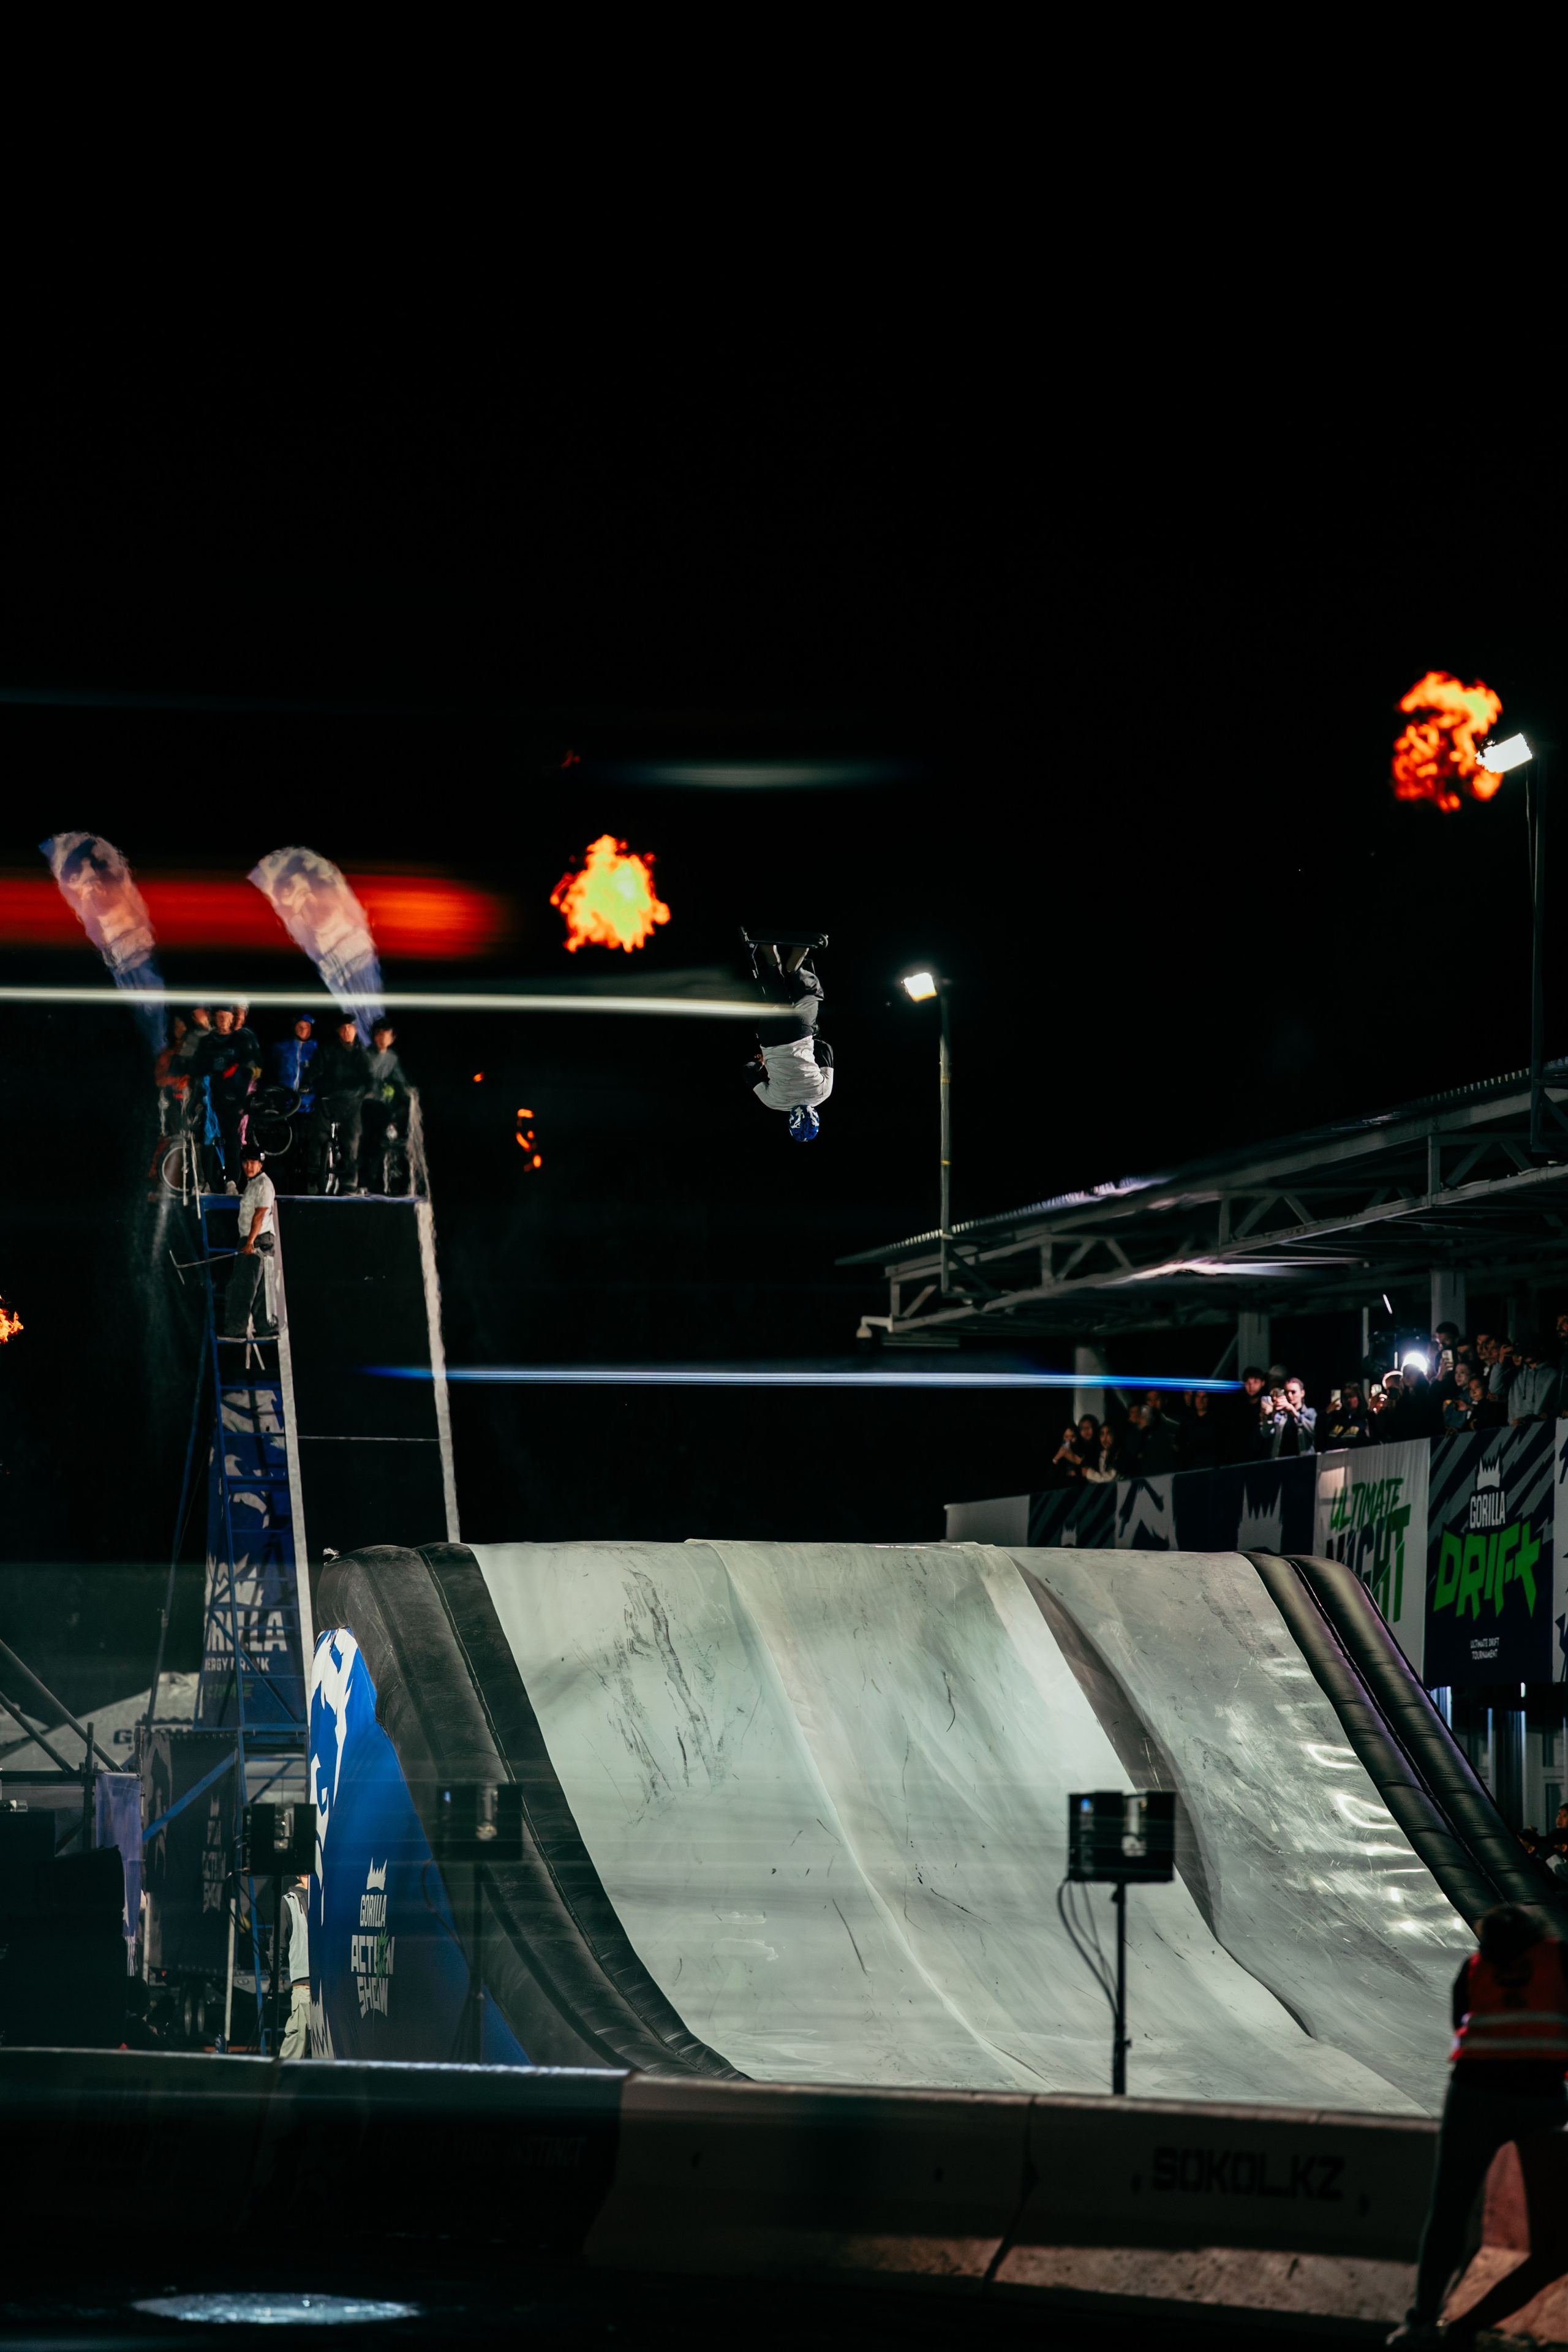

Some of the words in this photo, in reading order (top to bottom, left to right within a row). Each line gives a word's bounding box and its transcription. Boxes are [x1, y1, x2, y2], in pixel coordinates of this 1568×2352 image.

[1330, 1478, 1404, 1532] ULTIMATE
[1470, 1491, 1506, 1529] GORILLA
[1433, 1520, 1541, 1623] DRIFT
[360, 1894, 388, 1928] GORILLA
[350, 1934, 396, 1975] ACTION
[356, 1975, 389, 2019] SHOW
